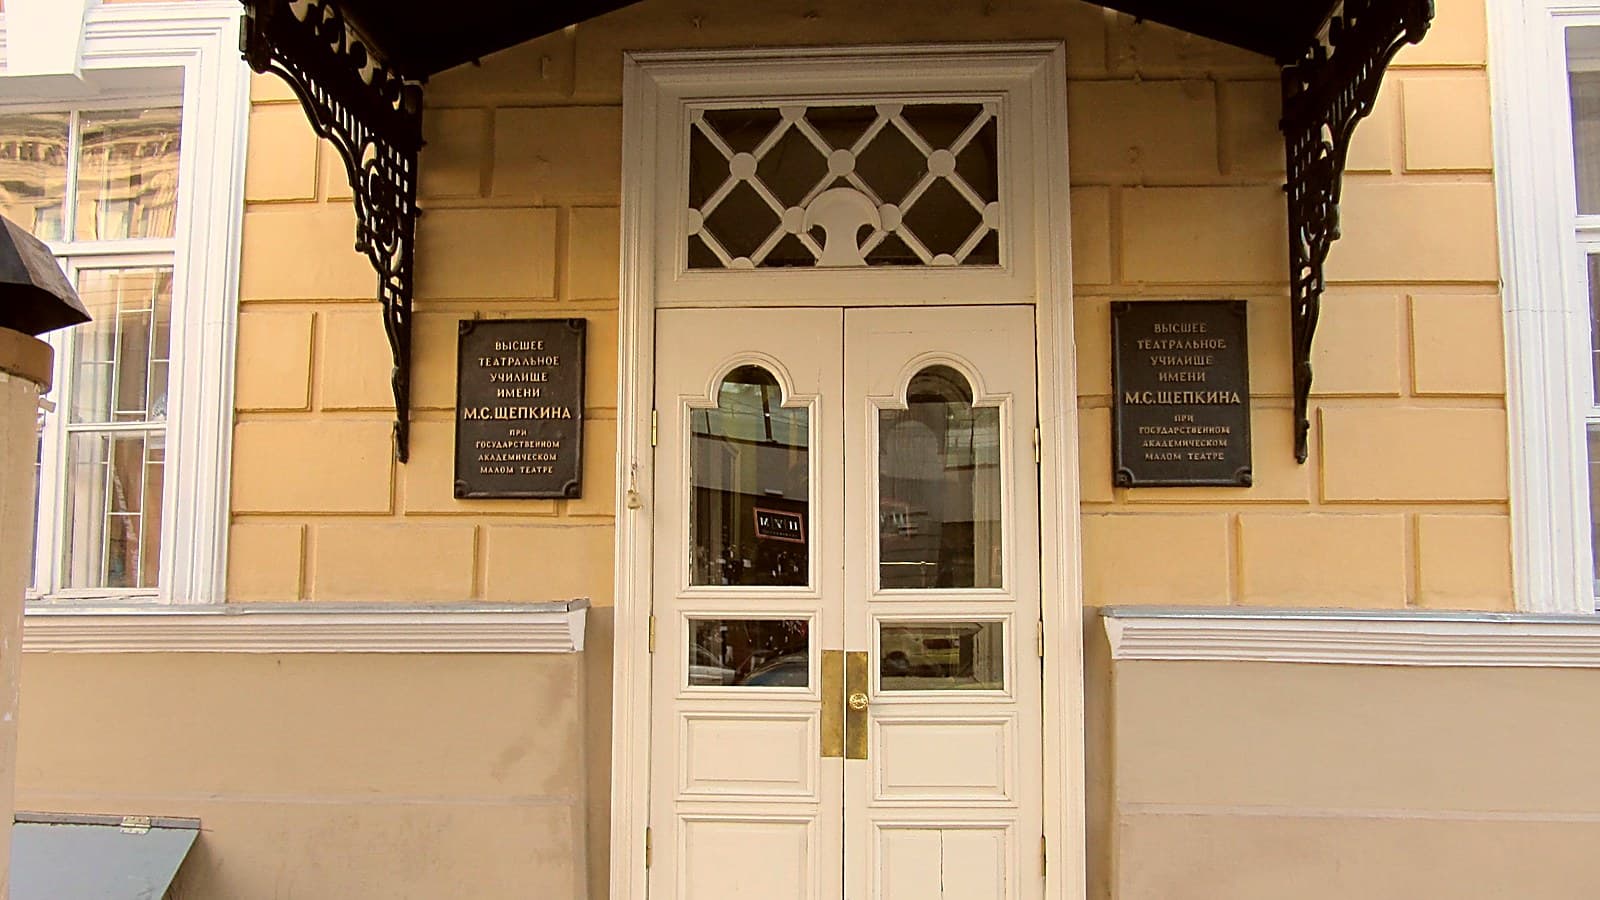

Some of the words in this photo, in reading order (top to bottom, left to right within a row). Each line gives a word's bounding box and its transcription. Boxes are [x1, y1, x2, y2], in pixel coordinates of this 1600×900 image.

[1154, 323, 1207, 334] ВЫСШЕЕ
[495, 340, 545, 352] ВЫСШЕЕ
[1137, 339, 1228, 350] ТЕАТРАЛЬНОЕ
[479, 356, 560, 368] ТЕАТРАЛЬНОЕ
[1159, 372, 1206, 383] ИМЕНИ
[497, 388, 542, 399] ИМЕНИ
[1174, 415, 1194, 423] ПРИ
[509, 429, 527, 437] ПРИ
[1139, 427, 1231, 435] ГОСУДАРСТВЕННОМ
[476, 441, 561, 450] ГОСУДАРСТВЕННОМ
[1143, 440, 1228, 448] АКАДЕМИЧЕСКОМ
[478, 454, 558, 462] АКАДЕМИЧЕСКОМ
[1145, 453, 1182, 461] МАЛОМ
[1188, 453, 1225, 461] ТЕАТРЕ
[480, 467, 514, 475] МАЛОМ
[520, 467, 554, 475] ТЕАТРЕ
